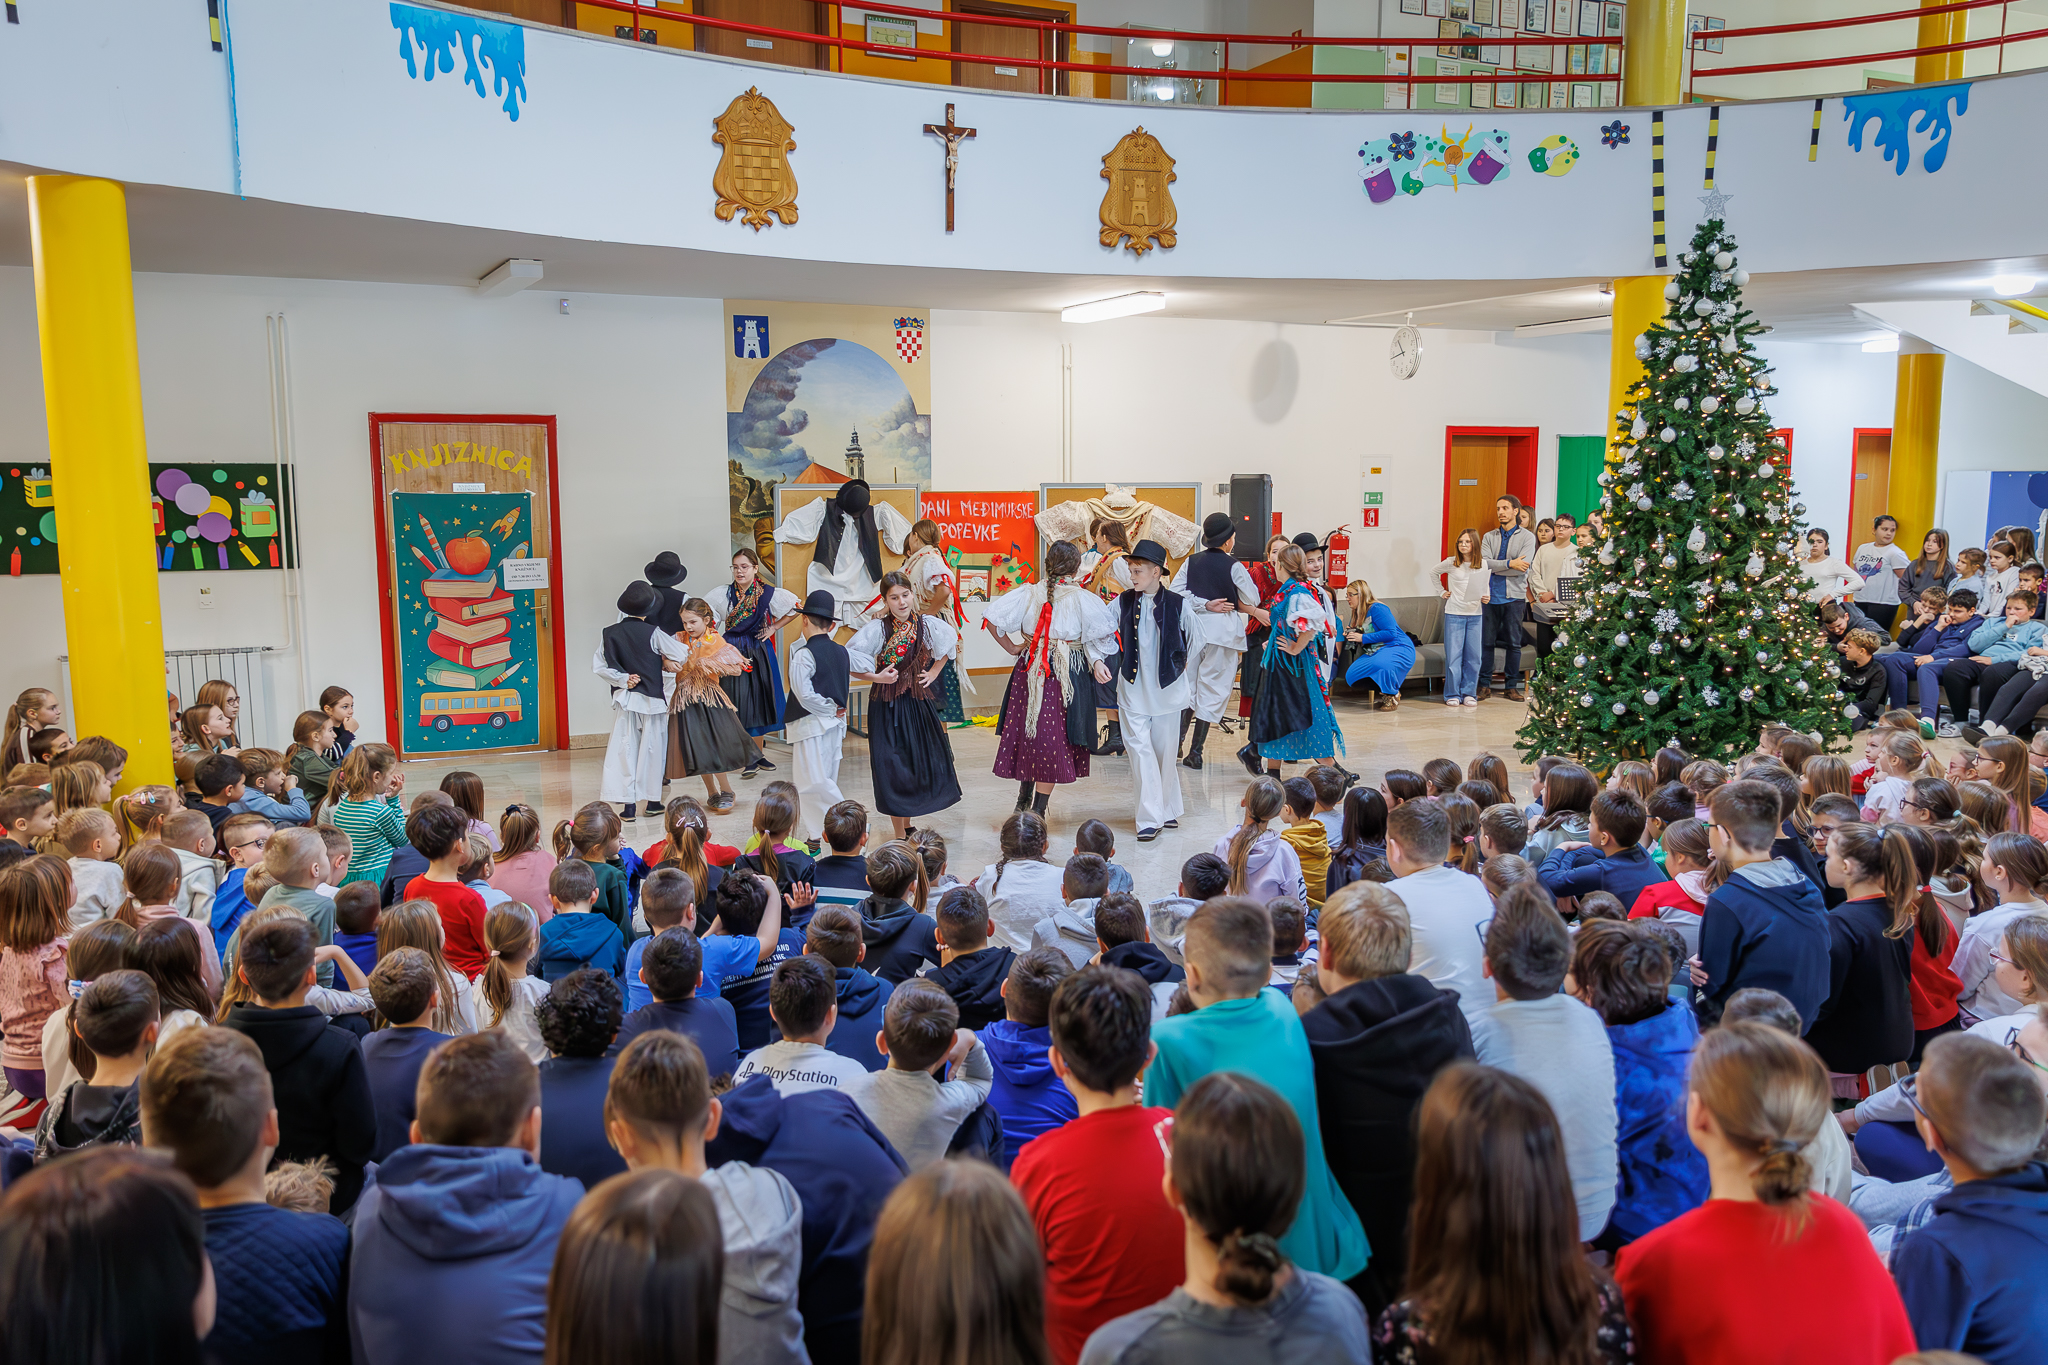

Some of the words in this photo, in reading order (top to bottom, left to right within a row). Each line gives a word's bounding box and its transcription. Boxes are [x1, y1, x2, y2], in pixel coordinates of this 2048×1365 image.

[920, 499, 950, 519] DANI
[960, 499, 1034, 520] MEĐIMURSKE
[938, 522, 1001, 542] POPEVKE
[772, 953, 787, 961] THE
[776, 943, 790, 952] AND
[761, 1065, 838, 1086] PlayStation
